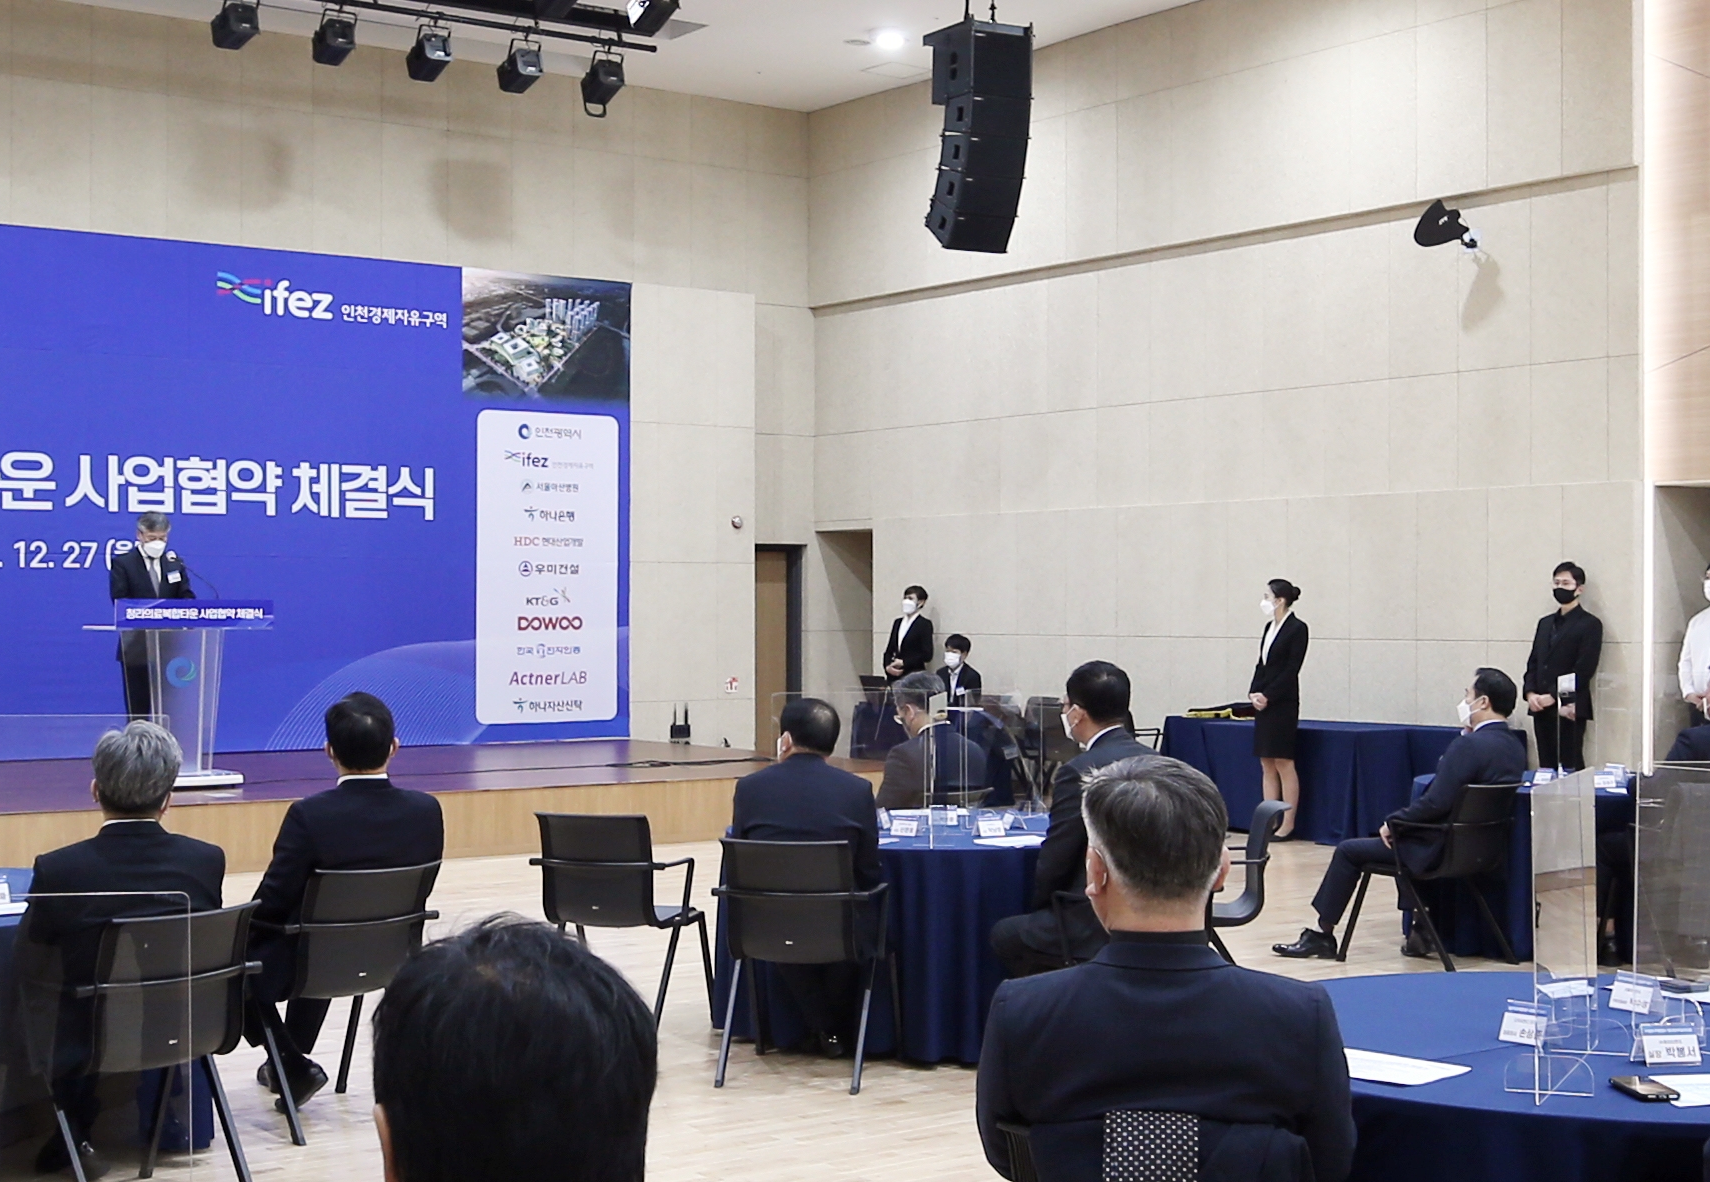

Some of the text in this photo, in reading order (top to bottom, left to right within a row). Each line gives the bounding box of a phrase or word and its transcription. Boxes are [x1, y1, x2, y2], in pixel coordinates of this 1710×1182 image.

[263, 279, 334, 320] ifez
[340, 304, 448, 328] 인천경제자유구역
[522, 452, 549, 467] ifez
[65, 453, 282, 517] 사업협약
[290, 461, 435, 522] 체결식
[539, 510, 575, 522] 하나은행
[514, 537, 540, 546] HDC
[14, 540, 55, 569] 12.
[62, 541, 99, 569] 27
[535, 564, 579, 575] 우미건설
[526, 595, 559, 606] KT&G
[126, 607, 264, 620] 청라의료복합타운 사업협약 체결식
[509, 671, 587, 685] ActnerLAB
[529, 700, 583, 712] 하나자산신탁
